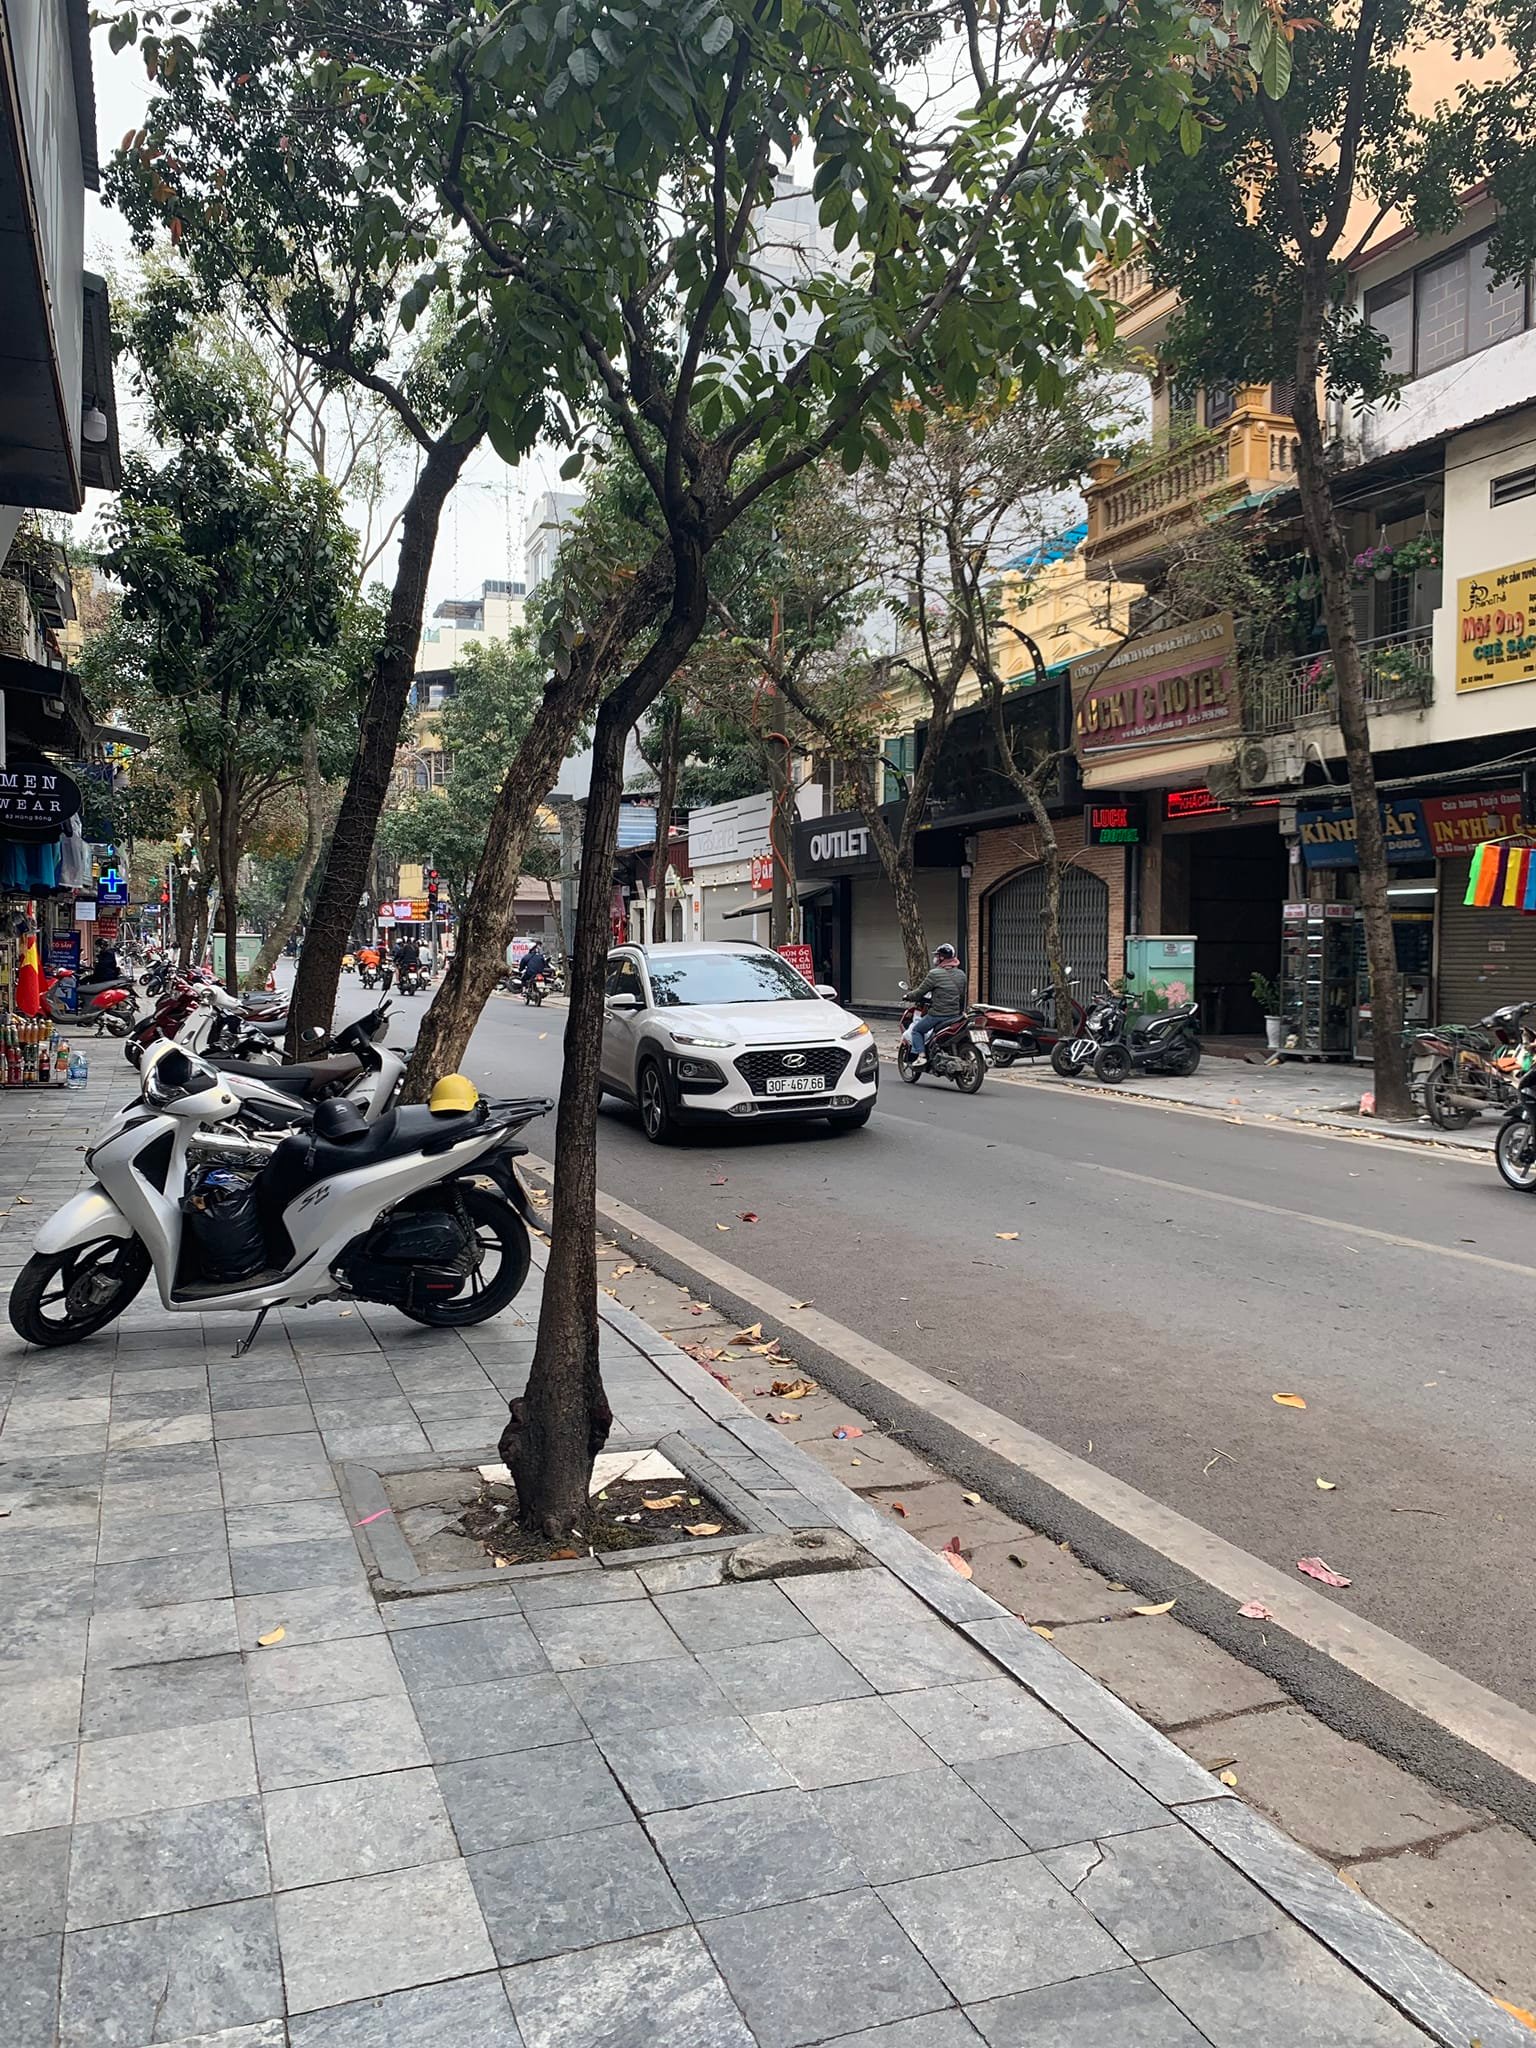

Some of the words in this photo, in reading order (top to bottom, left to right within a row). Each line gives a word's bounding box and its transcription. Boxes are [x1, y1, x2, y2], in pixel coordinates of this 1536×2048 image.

[1494, 609, 1525, 637] Ong
[1077, 687, 1137, 735] LUCKY
[1158, 667, 1227, 716] HOTEL
[0, 773, 58, 790] MEN
[0, 798, 62, 812] WEAR
[1093, 808, 1128, 828] LUCK
[1301, 815, 1359, 844] KÍNH
[1381, 804, 1418, 836] ẮT
[810, 827, 870, 862] OUTLET
[768, 1078, 824, 1092] 30F-467.66
